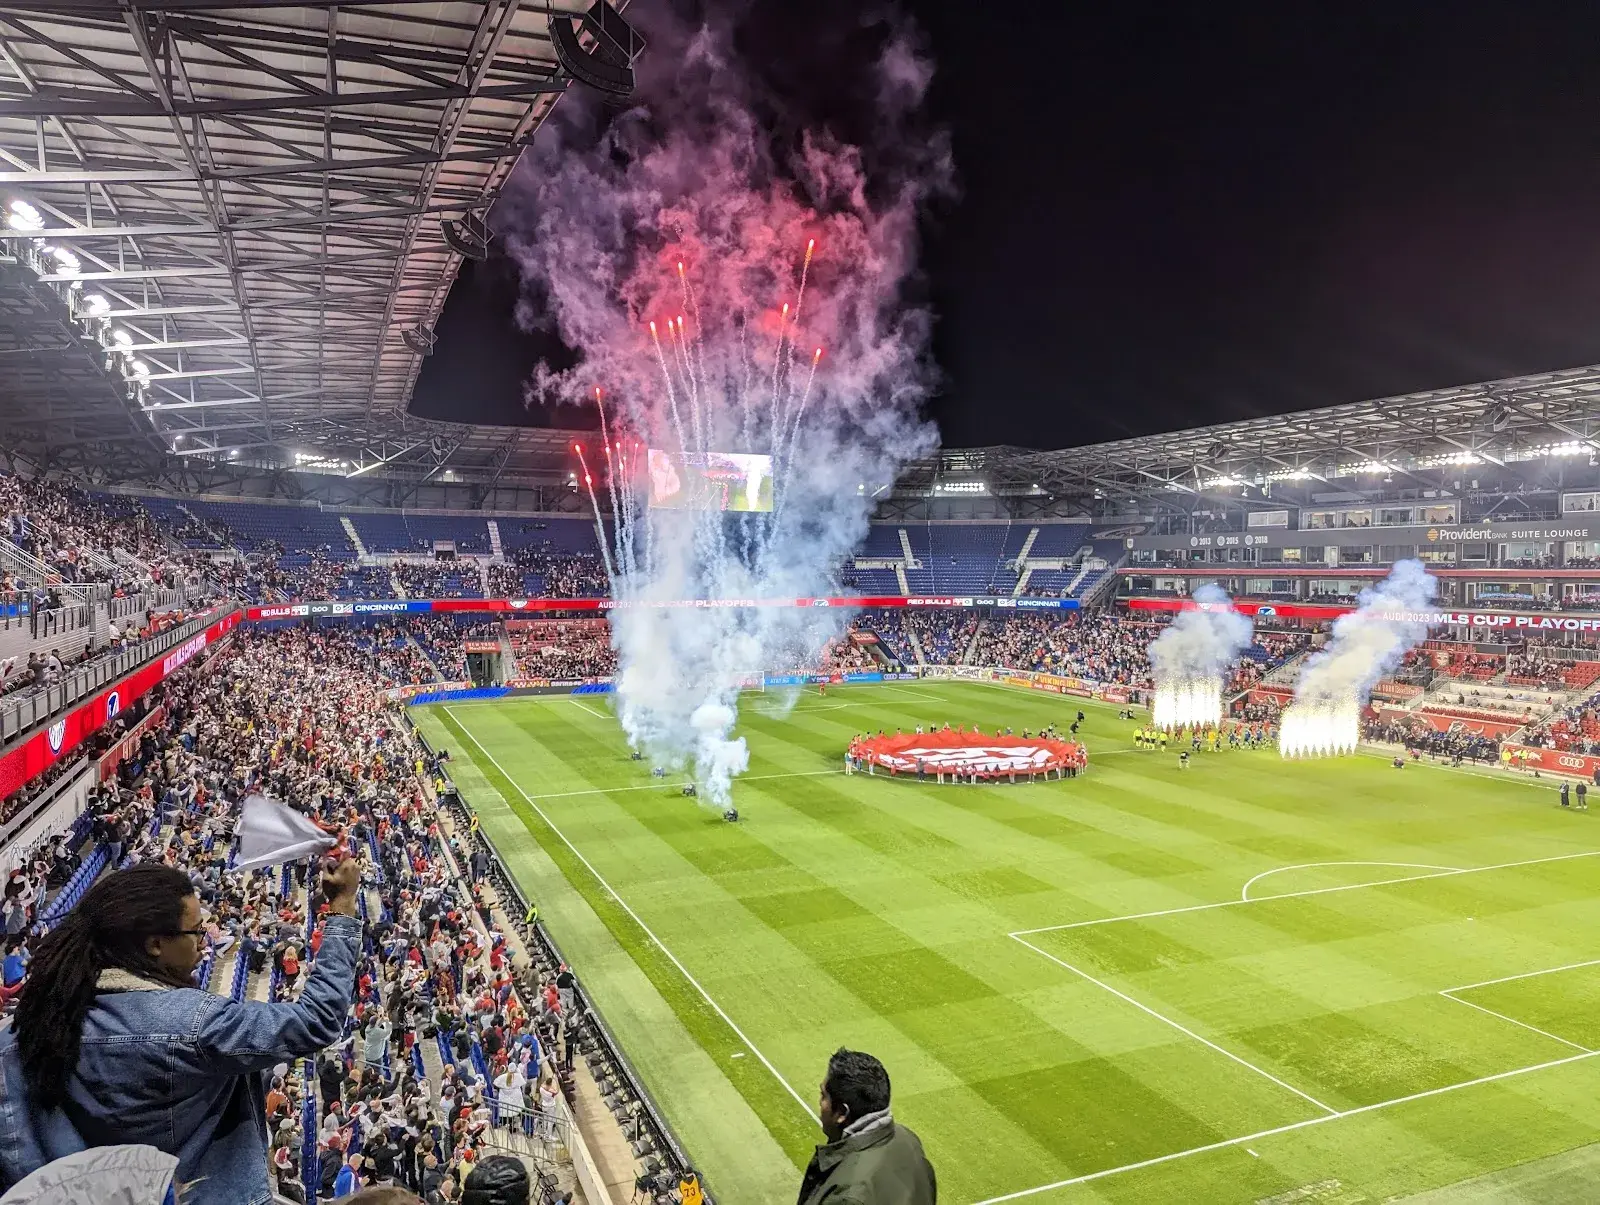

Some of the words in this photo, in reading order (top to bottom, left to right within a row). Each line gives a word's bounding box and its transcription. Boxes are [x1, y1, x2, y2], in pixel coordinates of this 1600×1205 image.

[1439, 527, 1492, 540] Provident
[1511, 530, 1541, 539] SUITE
[1544, 528, 1589, 538] LOUNGE
[1199, 537, 1212, 546] 2013
[1226, 536, 1239, 545] 2015
[1254, 535, 1268, 544] 2018
[355, 603, 408, 612] CINCINNATI
[695, 599, 755, 608] PLAYOFFS
[260, 608, 271, 617] RED
[271, 607, 290, 616] BULLS
[1382, 612, 1404, 621] AUDI
[1407, 613, 1430, 622] 2023
[1433, 613, 1470, 625] MLS
[1473, 615, 1512, 627] CUP
[1515, 616, 1600, 631] PLAYOFF
[684, 1187, 696, 1197] 73
